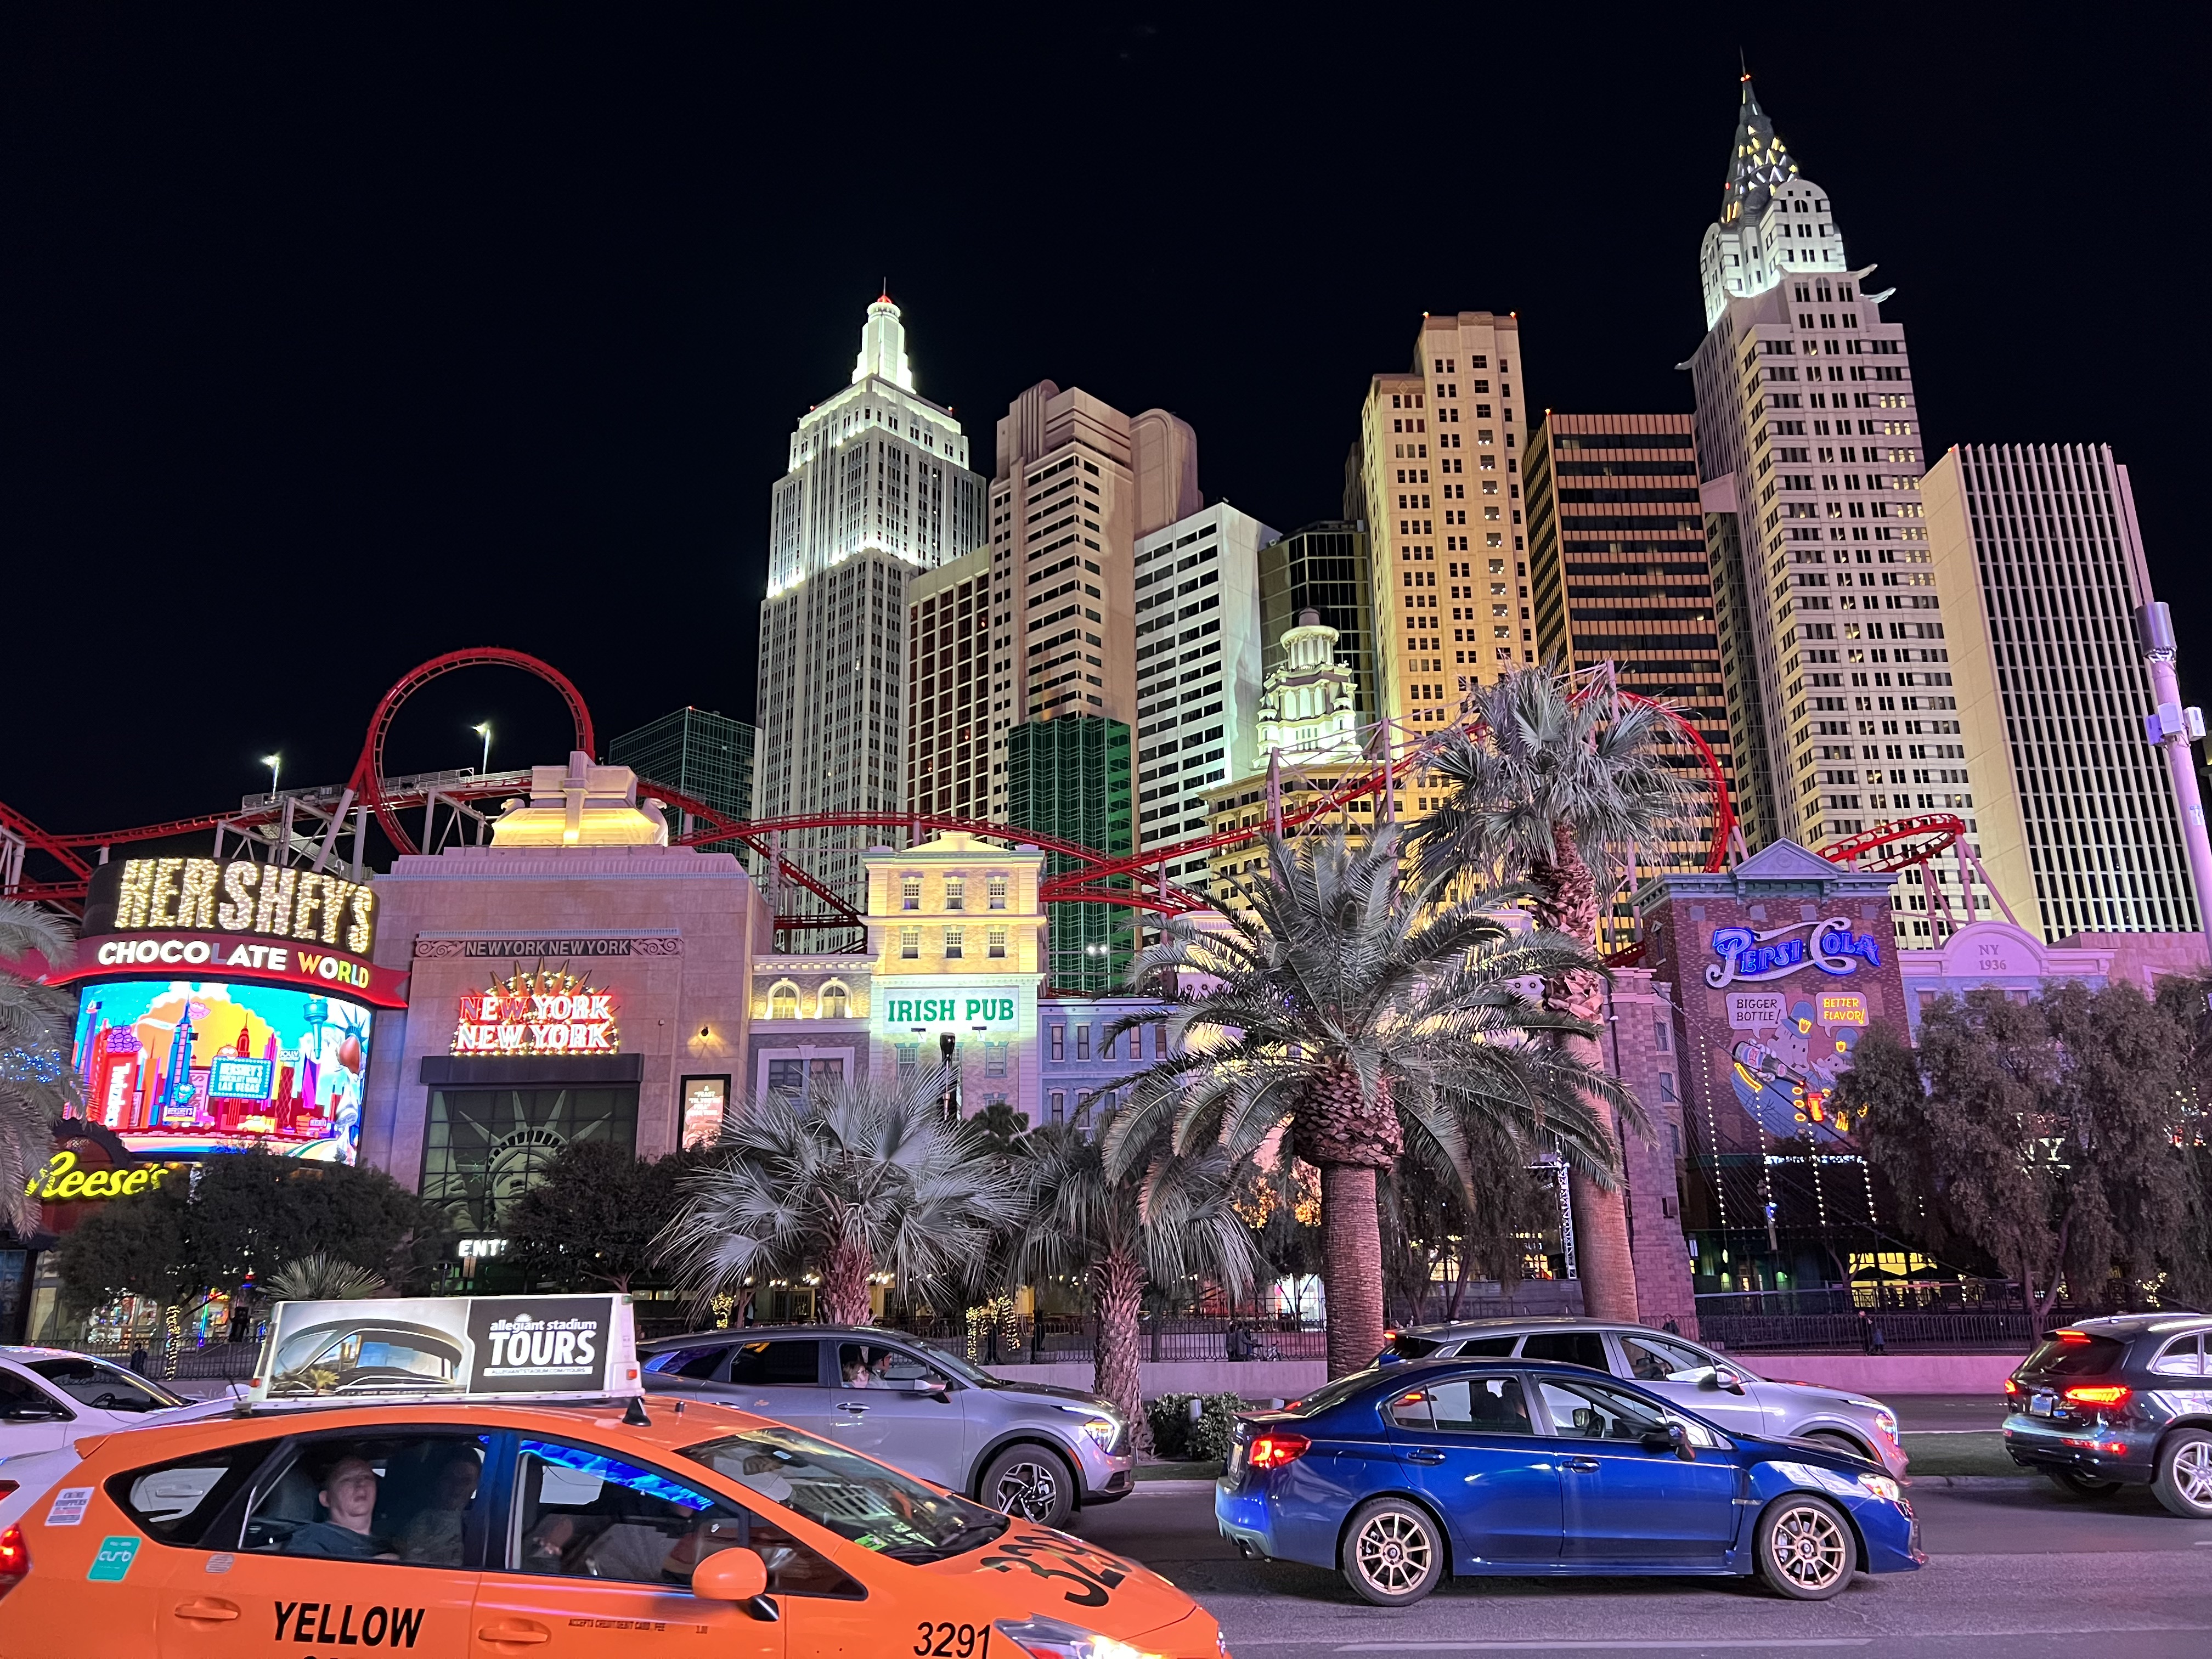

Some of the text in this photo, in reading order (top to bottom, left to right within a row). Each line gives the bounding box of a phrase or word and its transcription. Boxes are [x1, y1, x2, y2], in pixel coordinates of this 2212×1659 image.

[114, 857, 373, 953] HERSHEY'S
[1978, 944, 2000, 956] NY
[98, 939, 369, 989] CHOCOLATE WORLD
[1979, 959, 2007, 970] 1936
[460, 994, 612, 1021] NEW YORK
[888, 998, 1014, 1022] IRISH PUB
[1736, 998, 1778, 1008] BIGGER
[1822, 998, 1860, 1008] BETTER
[1736, 1008, 1781, 1025] BOTTLE!
[1824, 1008, 1865, 1024] FLAVOR!
[455, 1023, 612, 1050] NEW YORK
[24, 1151, 169, 1198] Reese's
[490, 1318, 597, 1333] allegiant stadium
[488, 1330, 597, 1366] TOURS
[99, 1550, 132, 1562] curb
[274, 1601, 426, 1648] YELLOW
[913, 1622, 991, 1659] 3291
